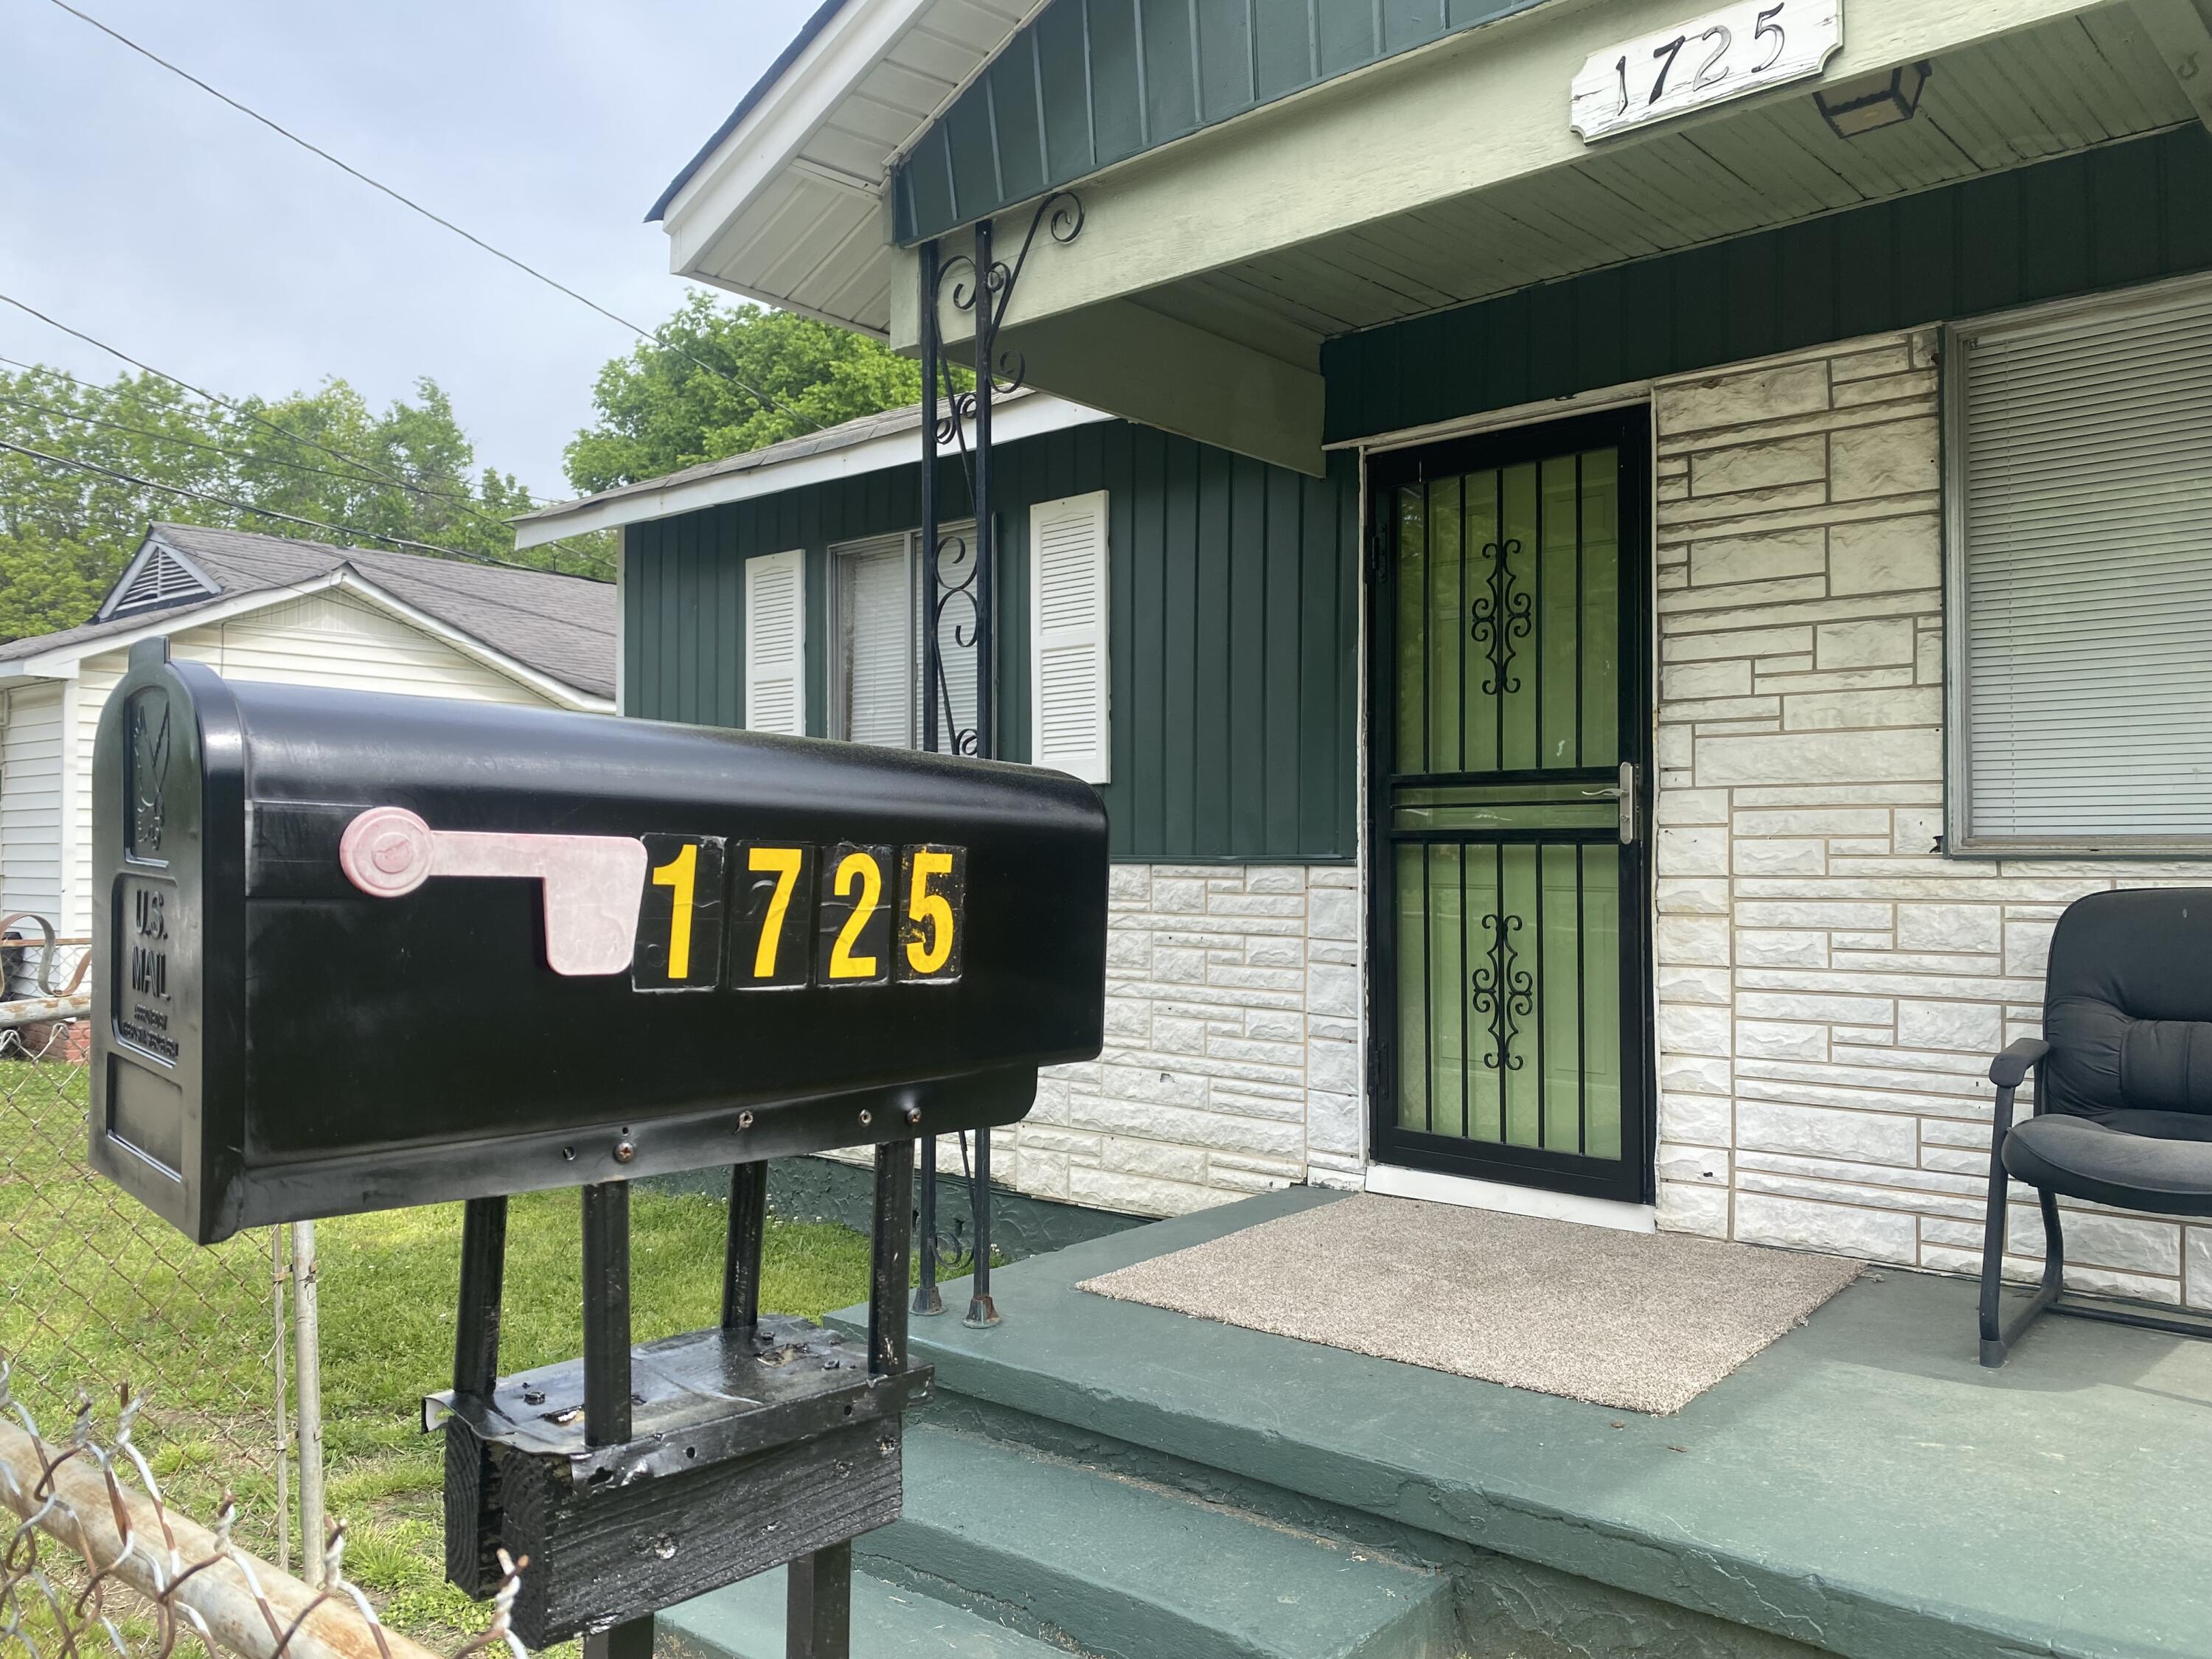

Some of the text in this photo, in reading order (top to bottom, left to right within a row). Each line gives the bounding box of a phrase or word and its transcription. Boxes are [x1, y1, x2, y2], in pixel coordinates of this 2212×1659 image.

[1615, 2, 1784, 116] 1725
[136, 889, 168, 939] U.S.
[653, 844, 953, 978] 1725
[132, 945, 171, 1001] MAIL
